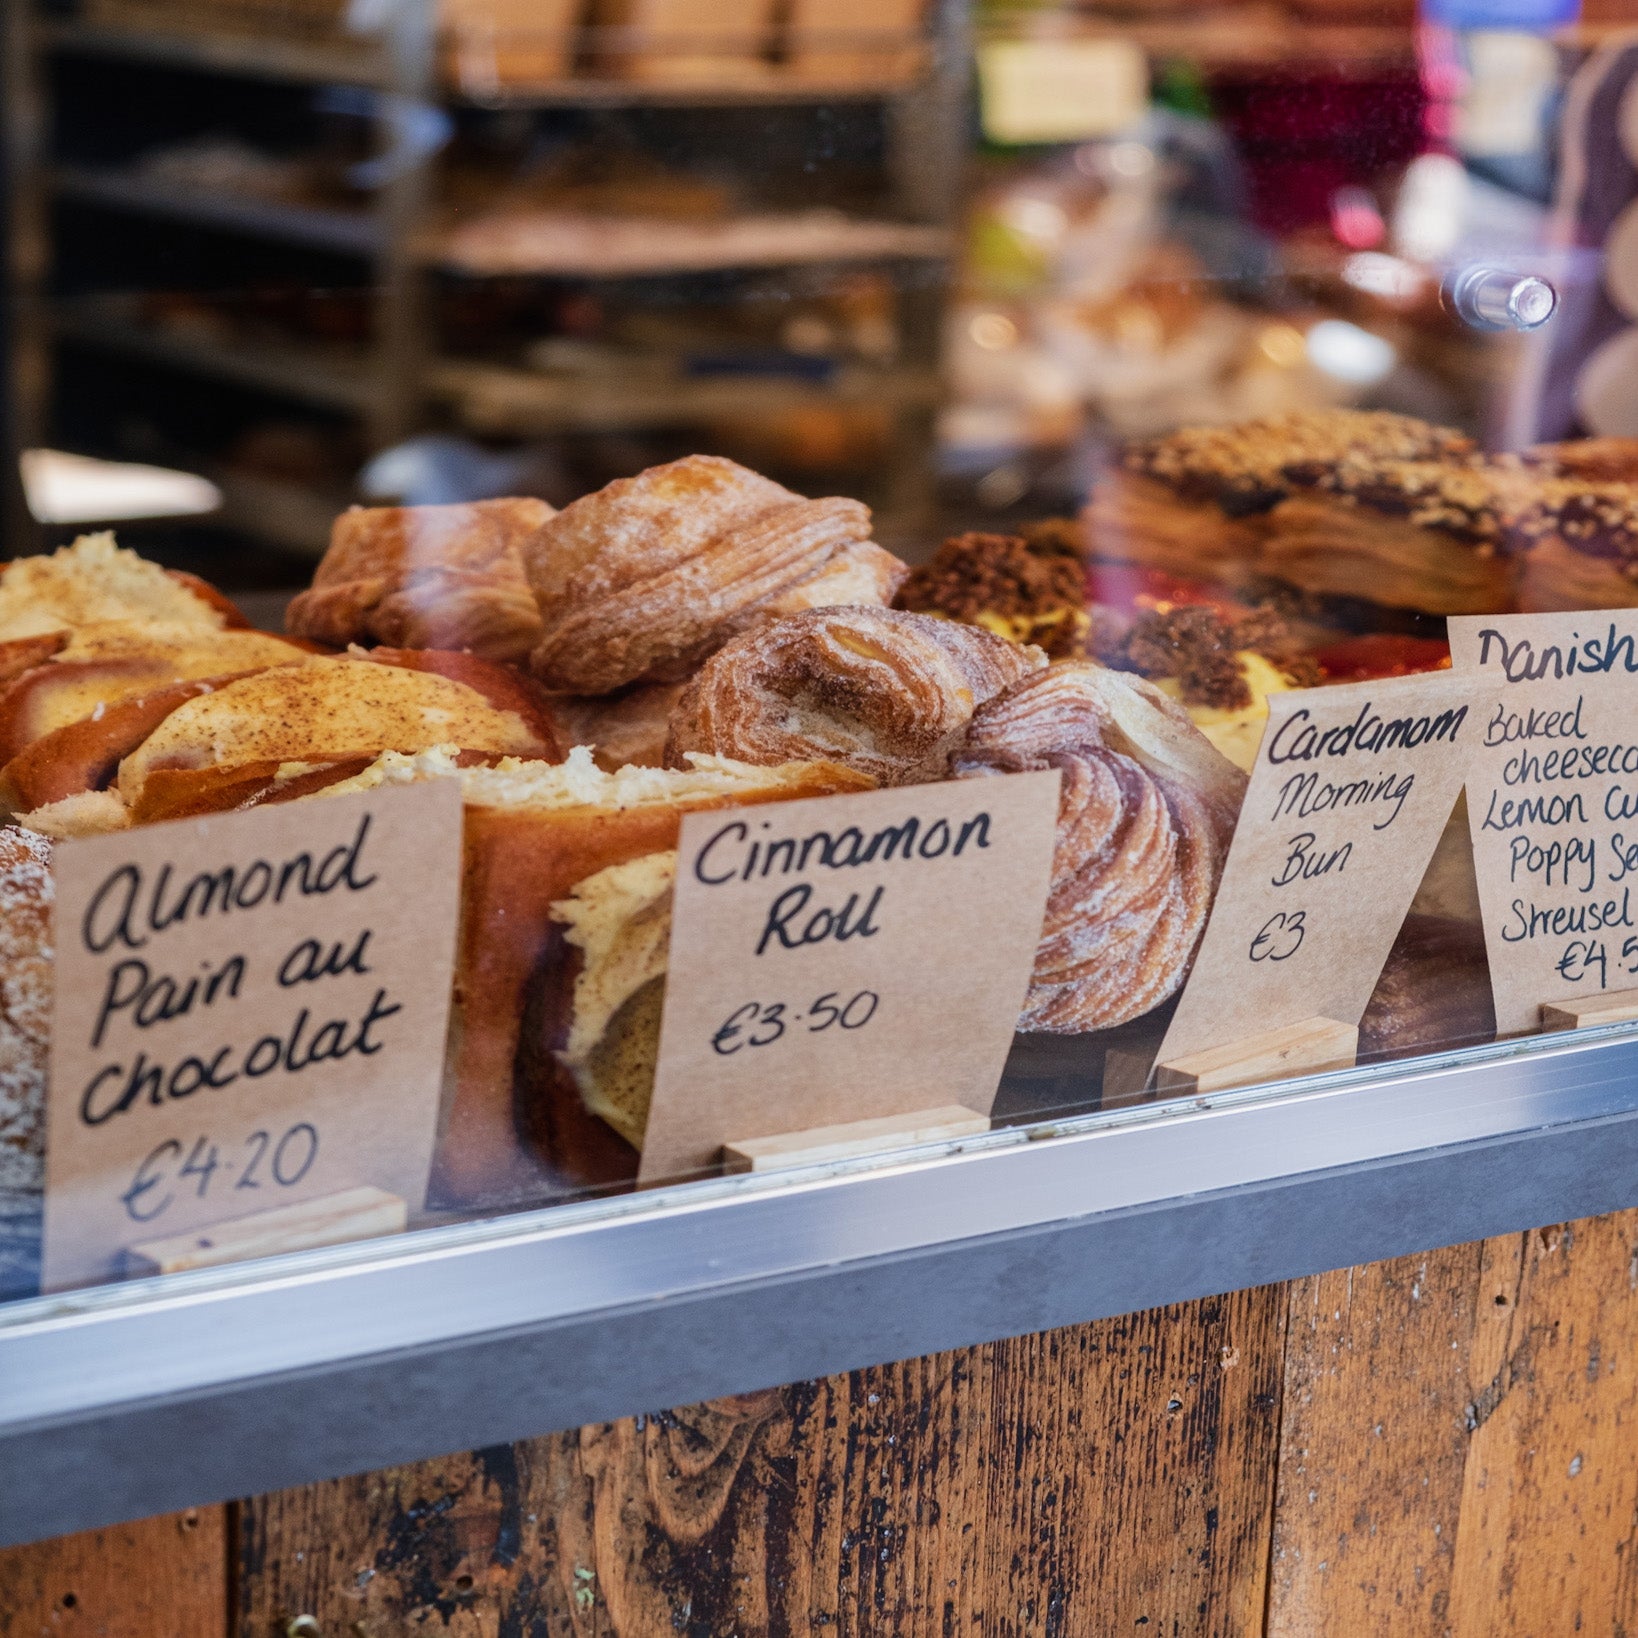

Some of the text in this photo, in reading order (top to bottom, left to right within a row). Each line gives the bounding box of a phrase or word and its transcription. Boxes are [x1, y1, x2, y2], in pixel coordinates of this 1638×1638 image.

[1478, 623, 1638, 683] Danish
[1268, 702, 1468, 765] Cardamom
[1483, 695, 1587, 747] Baked
[1271, 771, 1415, 831] Morning
[1481, 788, 1589, 831] Lemon
[695, 812, 991, 885] Cinnamon
[1271, 832, 1353, 887] Bun
[1510, 834, 1595, 893] Poppy
[83, 813, 377, 953] Almond
[755, 883, 885, 956] Roll
[1249, 911, 1306, 963] €3
[1501, 887, 1634, 942] Streusel
[90, 930, 372, 1047] Pain au
